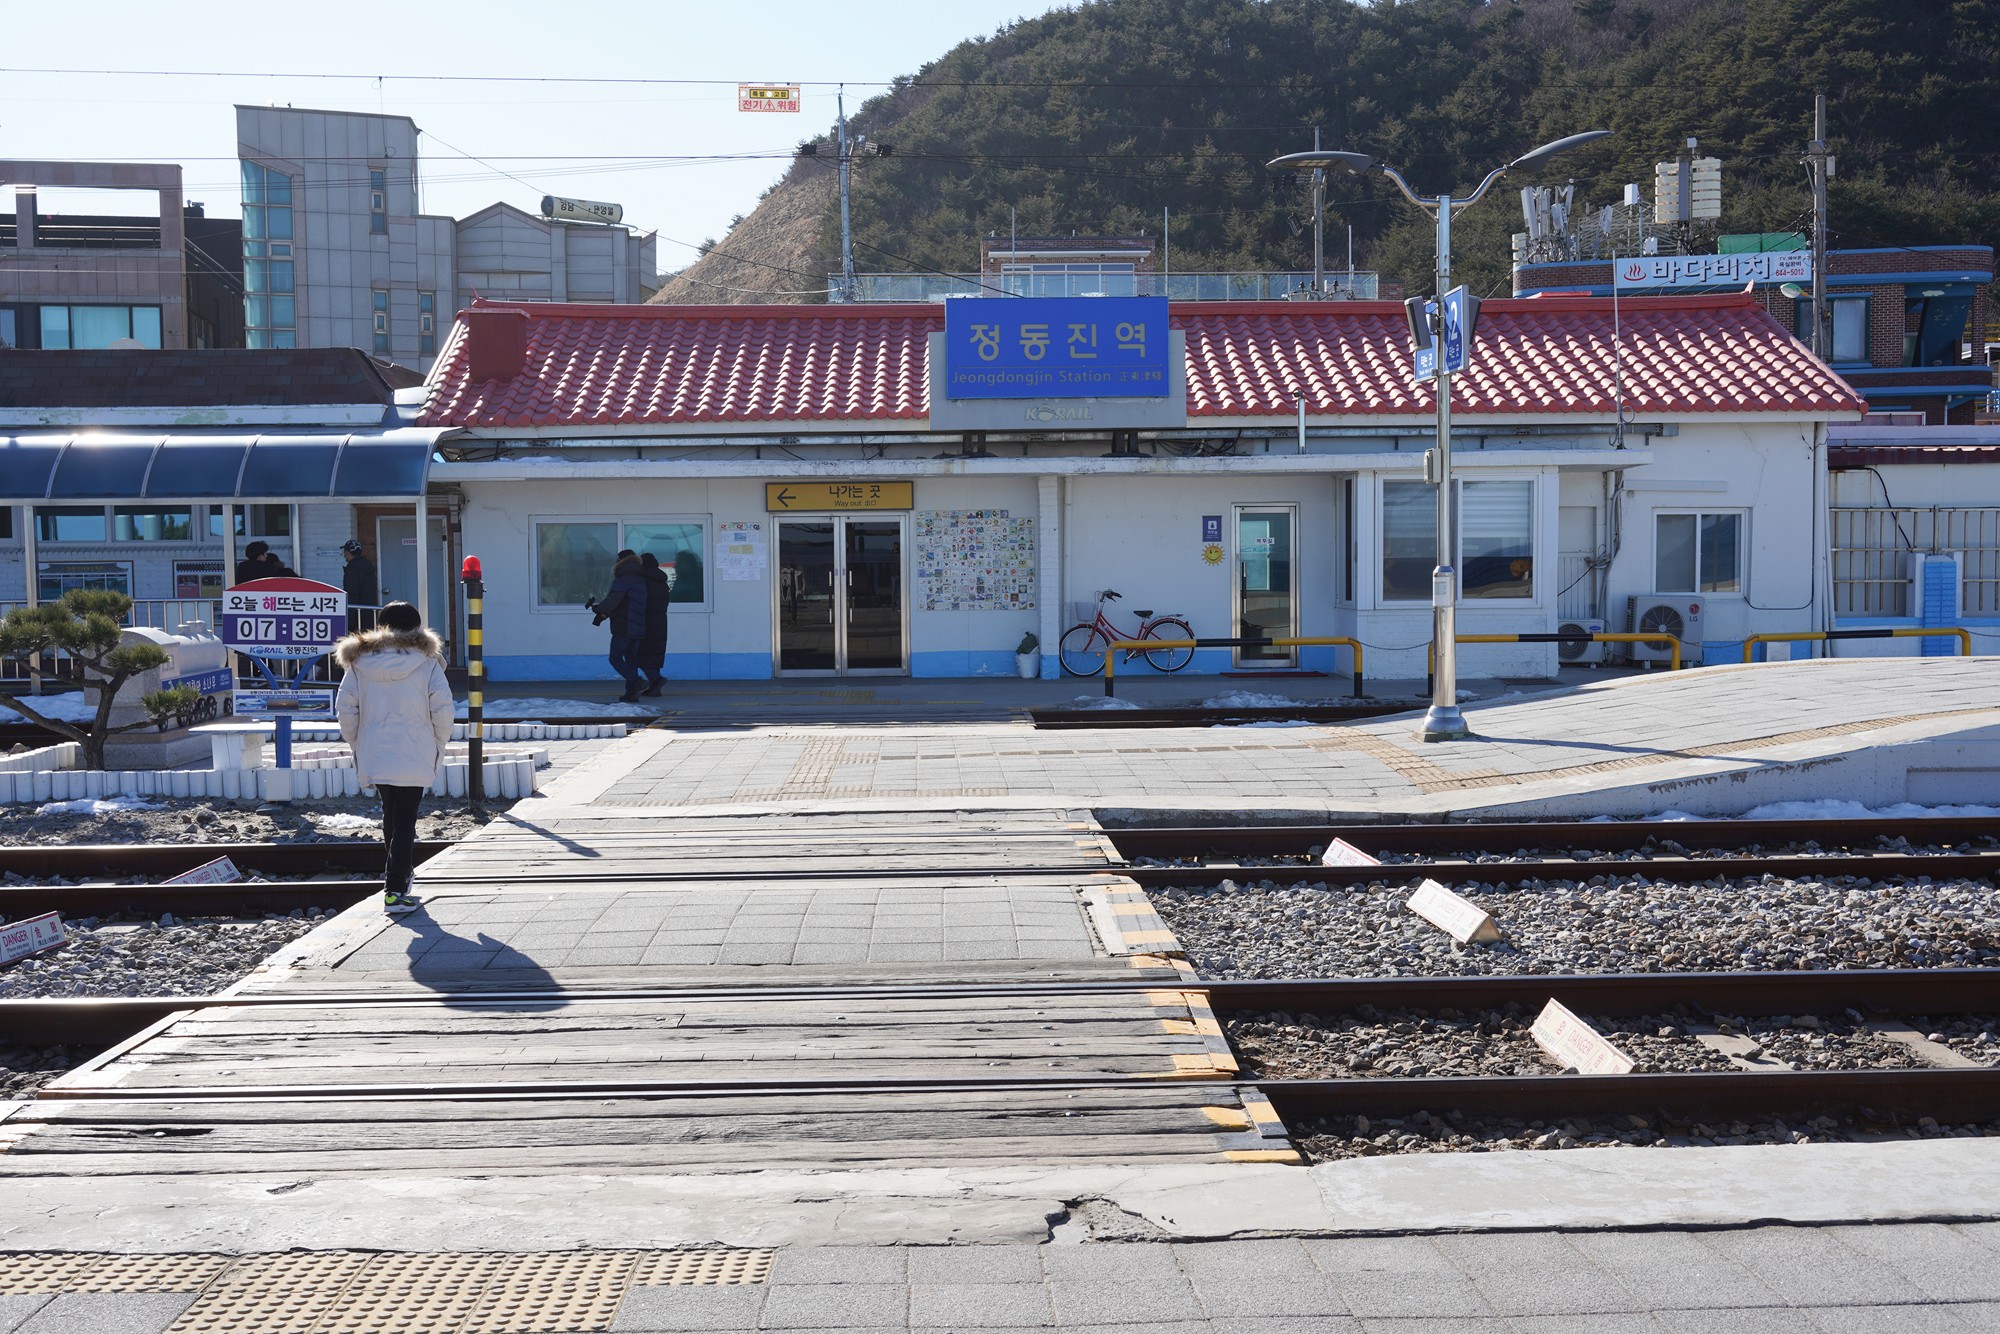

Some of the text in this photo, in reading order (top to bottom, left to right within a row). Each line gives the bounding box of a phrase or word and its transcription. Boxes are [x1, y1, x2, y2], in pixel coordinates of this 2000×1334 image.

[743, 100, 797, 111] 전기 위험
[1653, 257, 1770, 283] 바다비치
[1775, 269, 1805, 277] 644-5012
[1450, 300, 1458, 341] 2
[969, 322, 1146, 362] 정동진역
[952, 371, 1053, 386] Jeongdongjin
[1059, 370, 1111, 382] Station
[1025, 404, 1093, 422] KORAIL
[829, 485, 881, 498] 나가는 곳
[229, 596, 338, 612] 오늘 해뜨는 시각
[240, 620, 329, 638] 07:39
[249, 645, 318, 655] KORAIL 정동진역
[202, 675, 217, 690] 소나무
[2, 930, 29, 947] DANGER
[1568, 1029, 1593, 1056] DANGER
